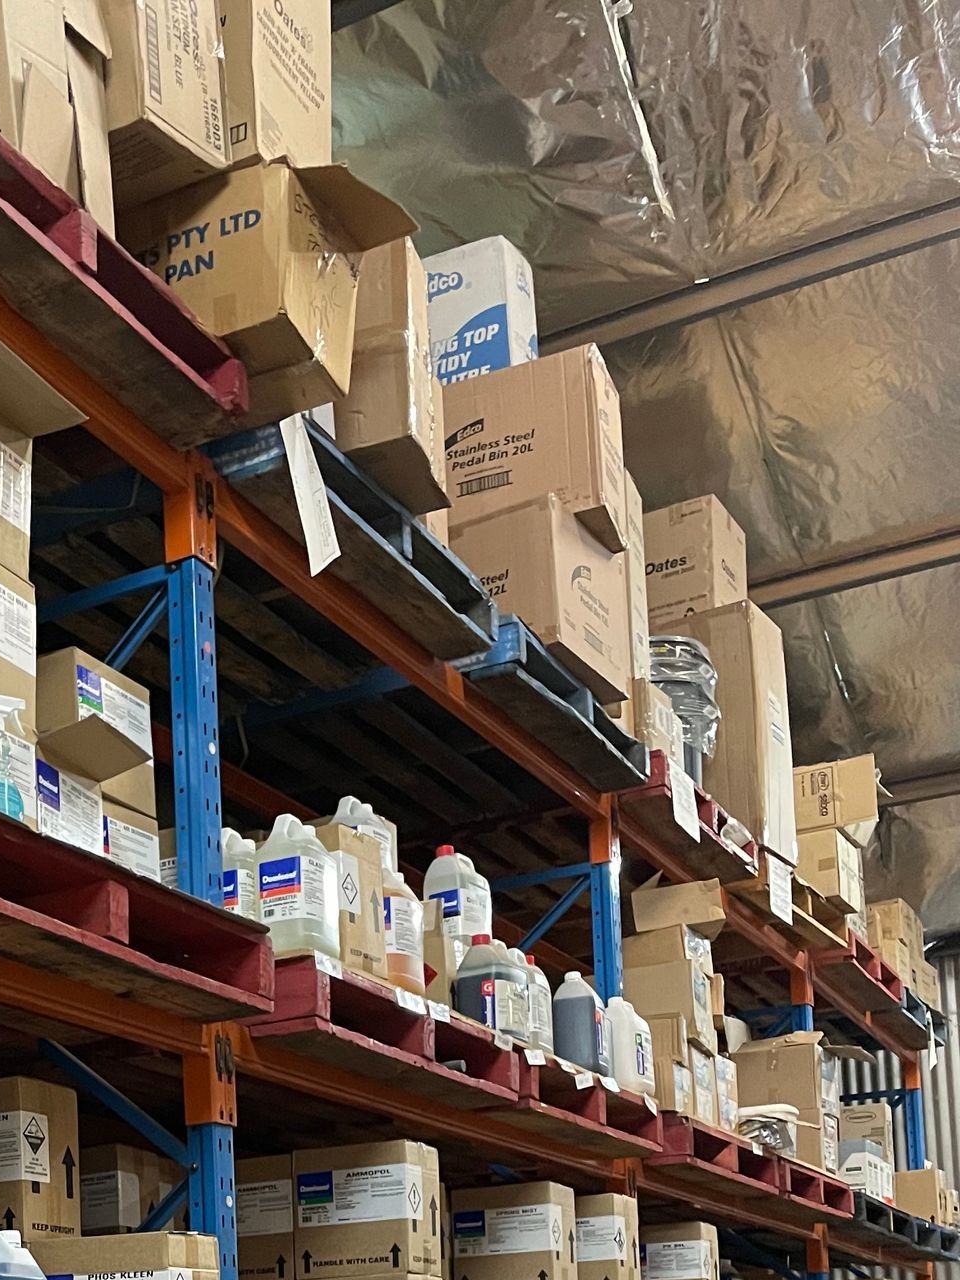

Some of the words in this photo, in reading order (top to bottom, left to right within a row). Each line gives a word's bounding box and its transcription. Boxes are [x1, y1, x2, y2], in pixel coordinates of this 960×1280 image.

[167, 222, 210, 251] PTY
[220, 209, 262, 237] LTD
[165, 251, 214, 284] PAN
[428, 271, 461, 294] dco
[464, 323, 500, 350] TOP
[456, 422, 483, 442] Edco
[446, 436, 501, 462] Stainless
[503, 428, 536, 449] Steel
[451, 452, 487, 472] Pedal
[488, 446, 510, 462] Bin
[512, 444, 535, 458] 20L
[645, 555, 688, 577] Oates
[346, 1168, 391, 1179] AMMOPOL
[31, 1222, 49, 1232] KEEP
[49, 1224, 75, 1236] UPRIGHT
[312, 1259, 344, 1268] HANDLE
[345, 1257, 367, 1266] WITH
[368, 1255, 391, 1265] CARE
[119, 1270, 155, 1280] KLEEN
